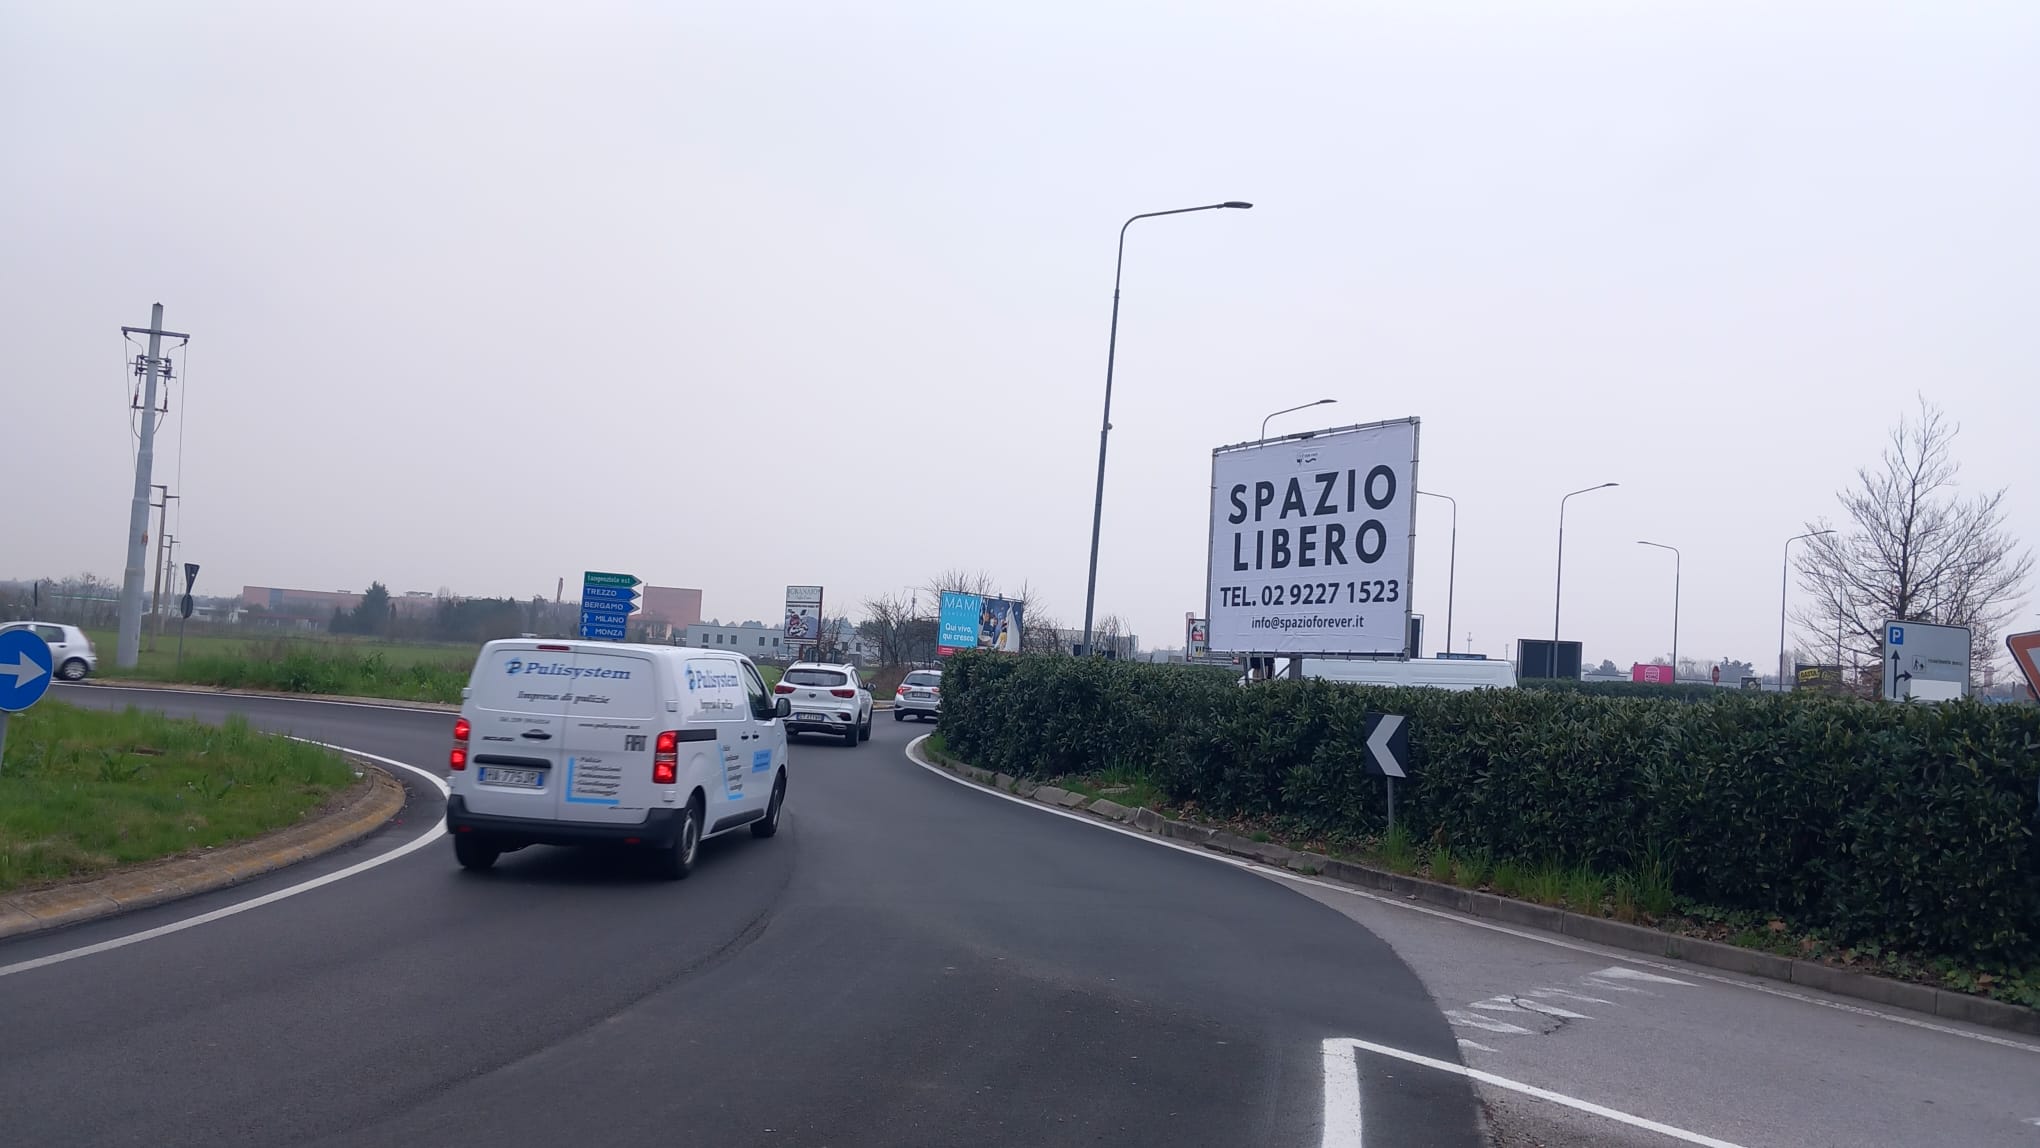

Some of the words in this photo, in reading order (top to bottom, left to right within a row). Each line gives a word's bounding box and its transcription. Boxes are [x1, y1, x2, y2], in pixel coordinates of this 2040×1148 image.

[1228, 464, 1397, 524] SPAZIO
[1233, 519, 1387, 571] LIBERO
[586, 588, 617, 597] TREZZO
[1220, 586, 1257, 607] TEL.
[1261, 585, 1285, 606] 02
[1289, 582, 1340, 606] 9227
[1347, 579, 1399, 604] 1523
[584, 601, 624, 610] BERGAMO
[943, 595, 978, 612] MAMI
[595, 615, 625, 624] MILANO
[1251, 615, 1364, 632] info@spazioforever.it
[594, 628, 623, 637] MONZA
[945, 622, 957, 633] Qui
[957, 624, 973, 634] vivo,
[942, 633, 953, 641] qui
[953, 634, 974, 642] cresco
[525, 661, 632, 680] Pulisystem
